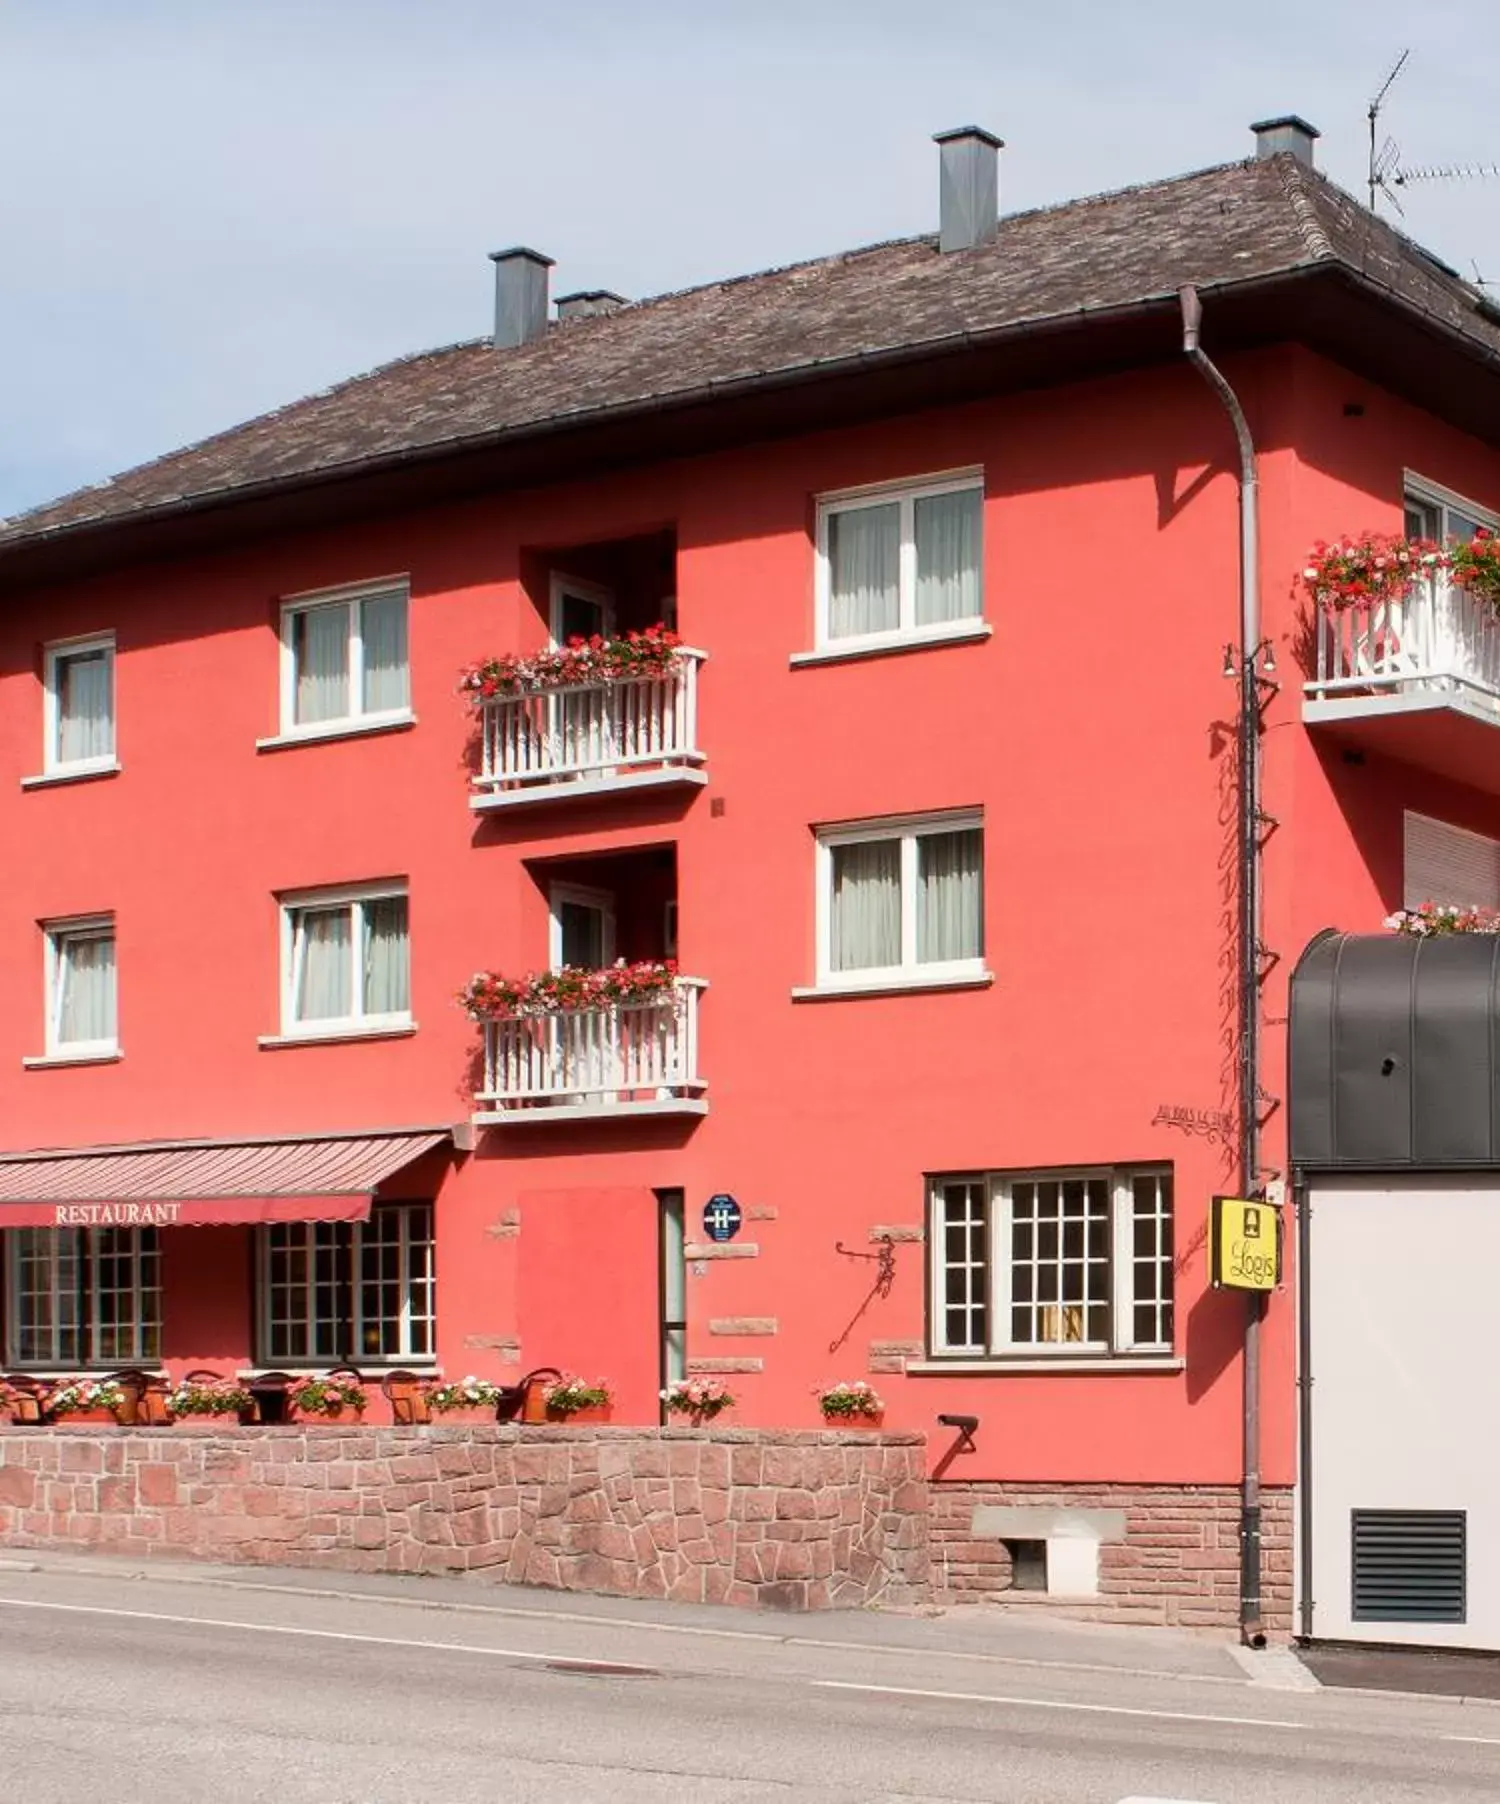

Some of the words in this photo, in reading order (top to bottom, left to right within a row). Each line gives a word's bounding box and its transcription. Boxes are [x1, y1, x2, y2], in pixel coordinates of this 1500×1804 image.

[55, 1203, 181, 1225] RESTAURANT
[714, 1209, 729, 1229] H
[1230, 1239, 1275, 1286] Logis
